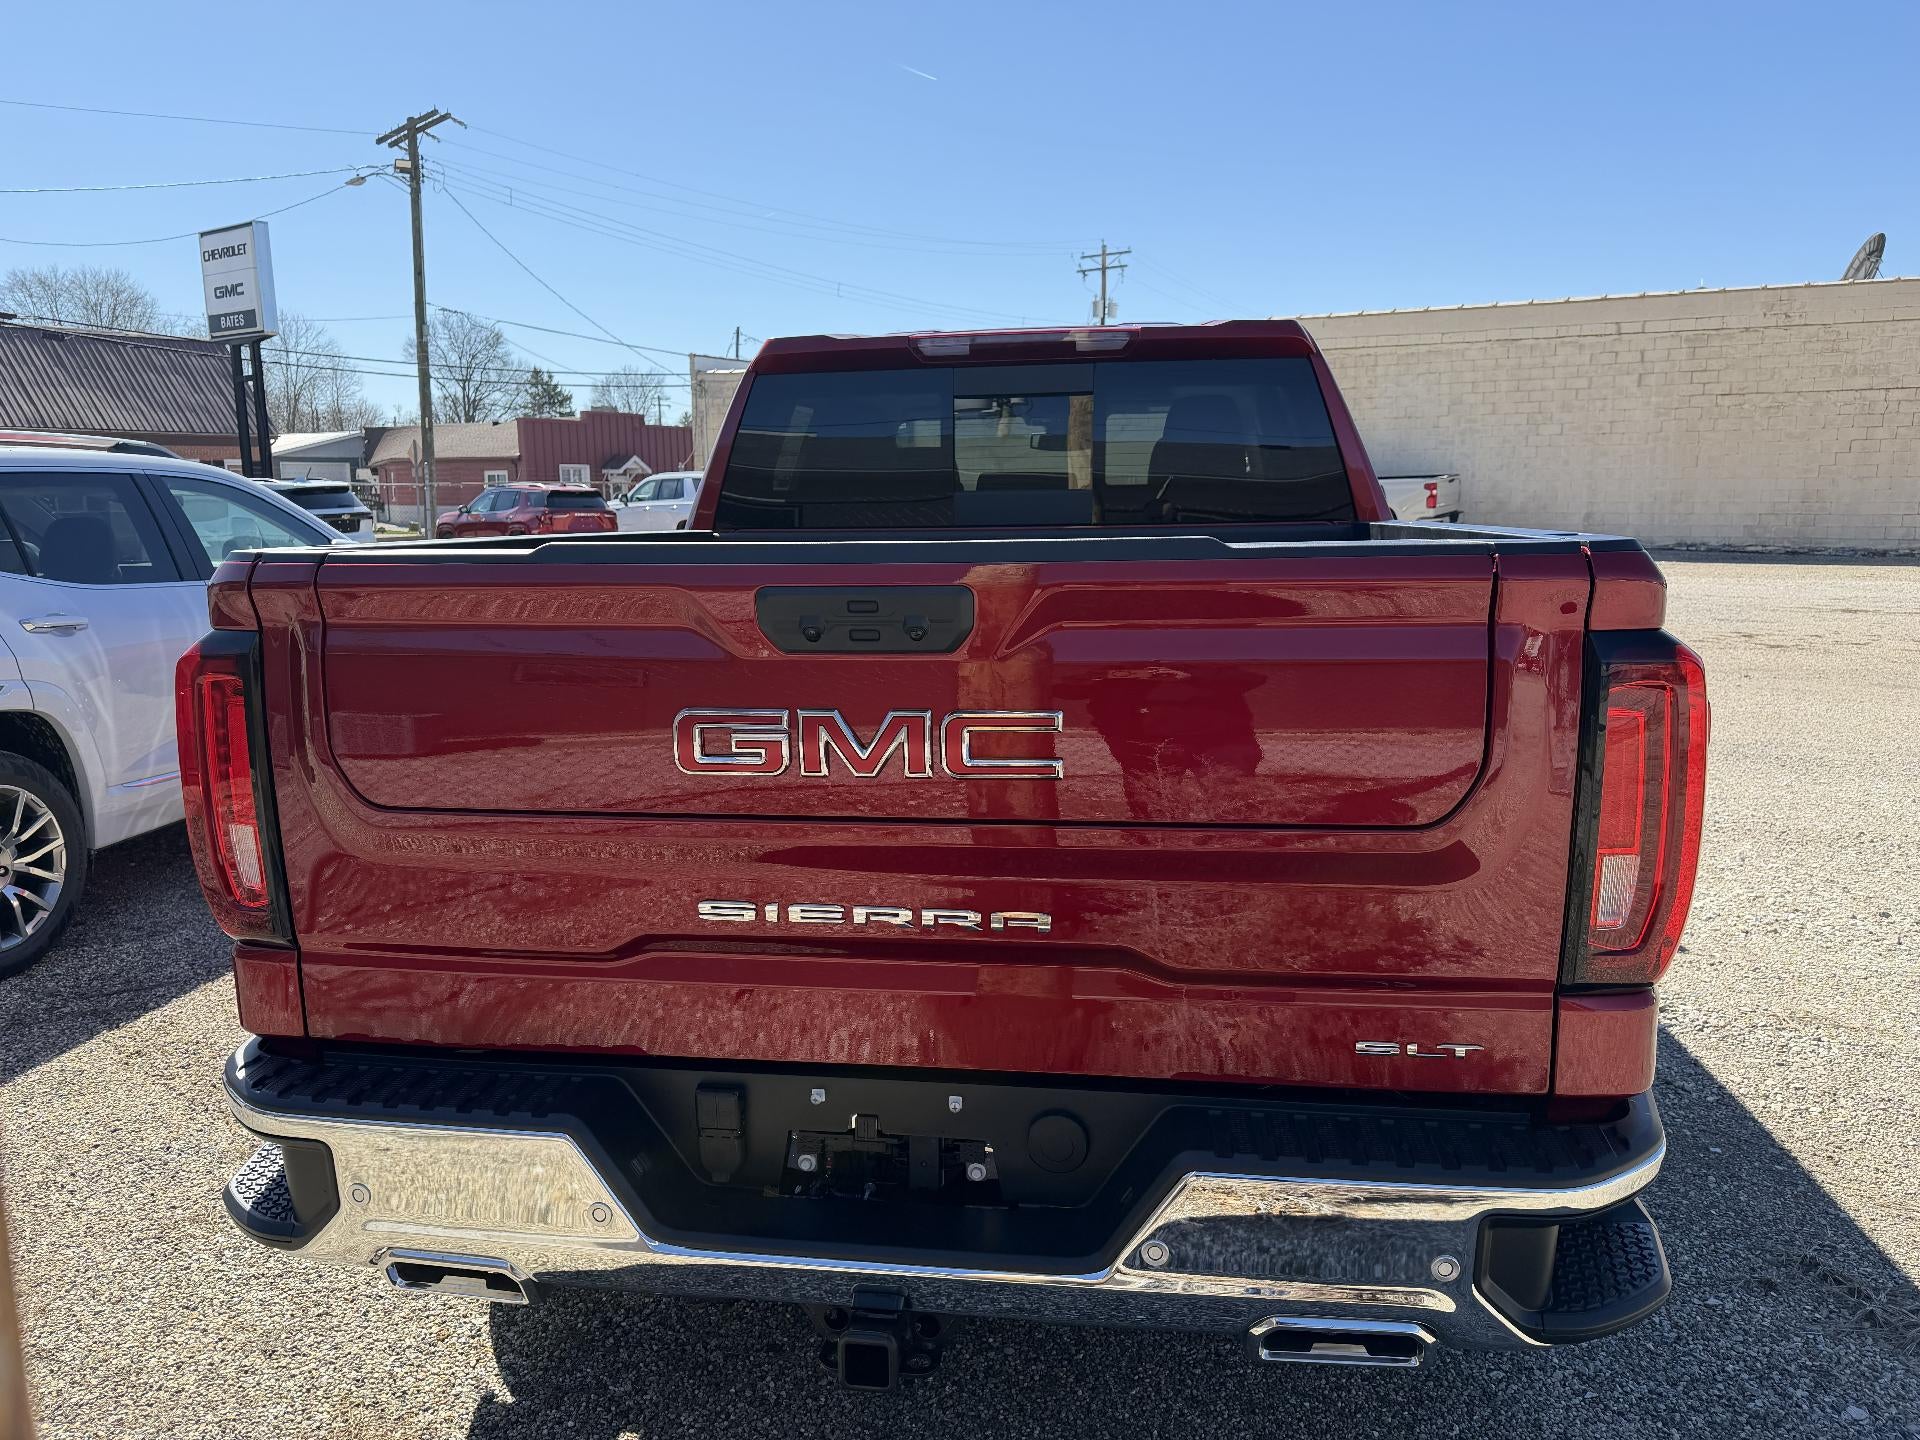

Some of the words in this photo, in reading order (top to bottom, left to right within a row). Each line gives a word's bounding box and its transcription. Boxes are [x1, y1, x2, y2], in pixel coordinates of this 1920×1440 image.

[203, 243, 247, 262] CHEVROLET
[214, 282, 245, 299] GMC
[220, 314, 245, 329] BATES
[672, 707, 1064, 779] GMC
[697, 899, 1052, 933] SIERRA
[1355, 1041, 1485, 1058] SLT
